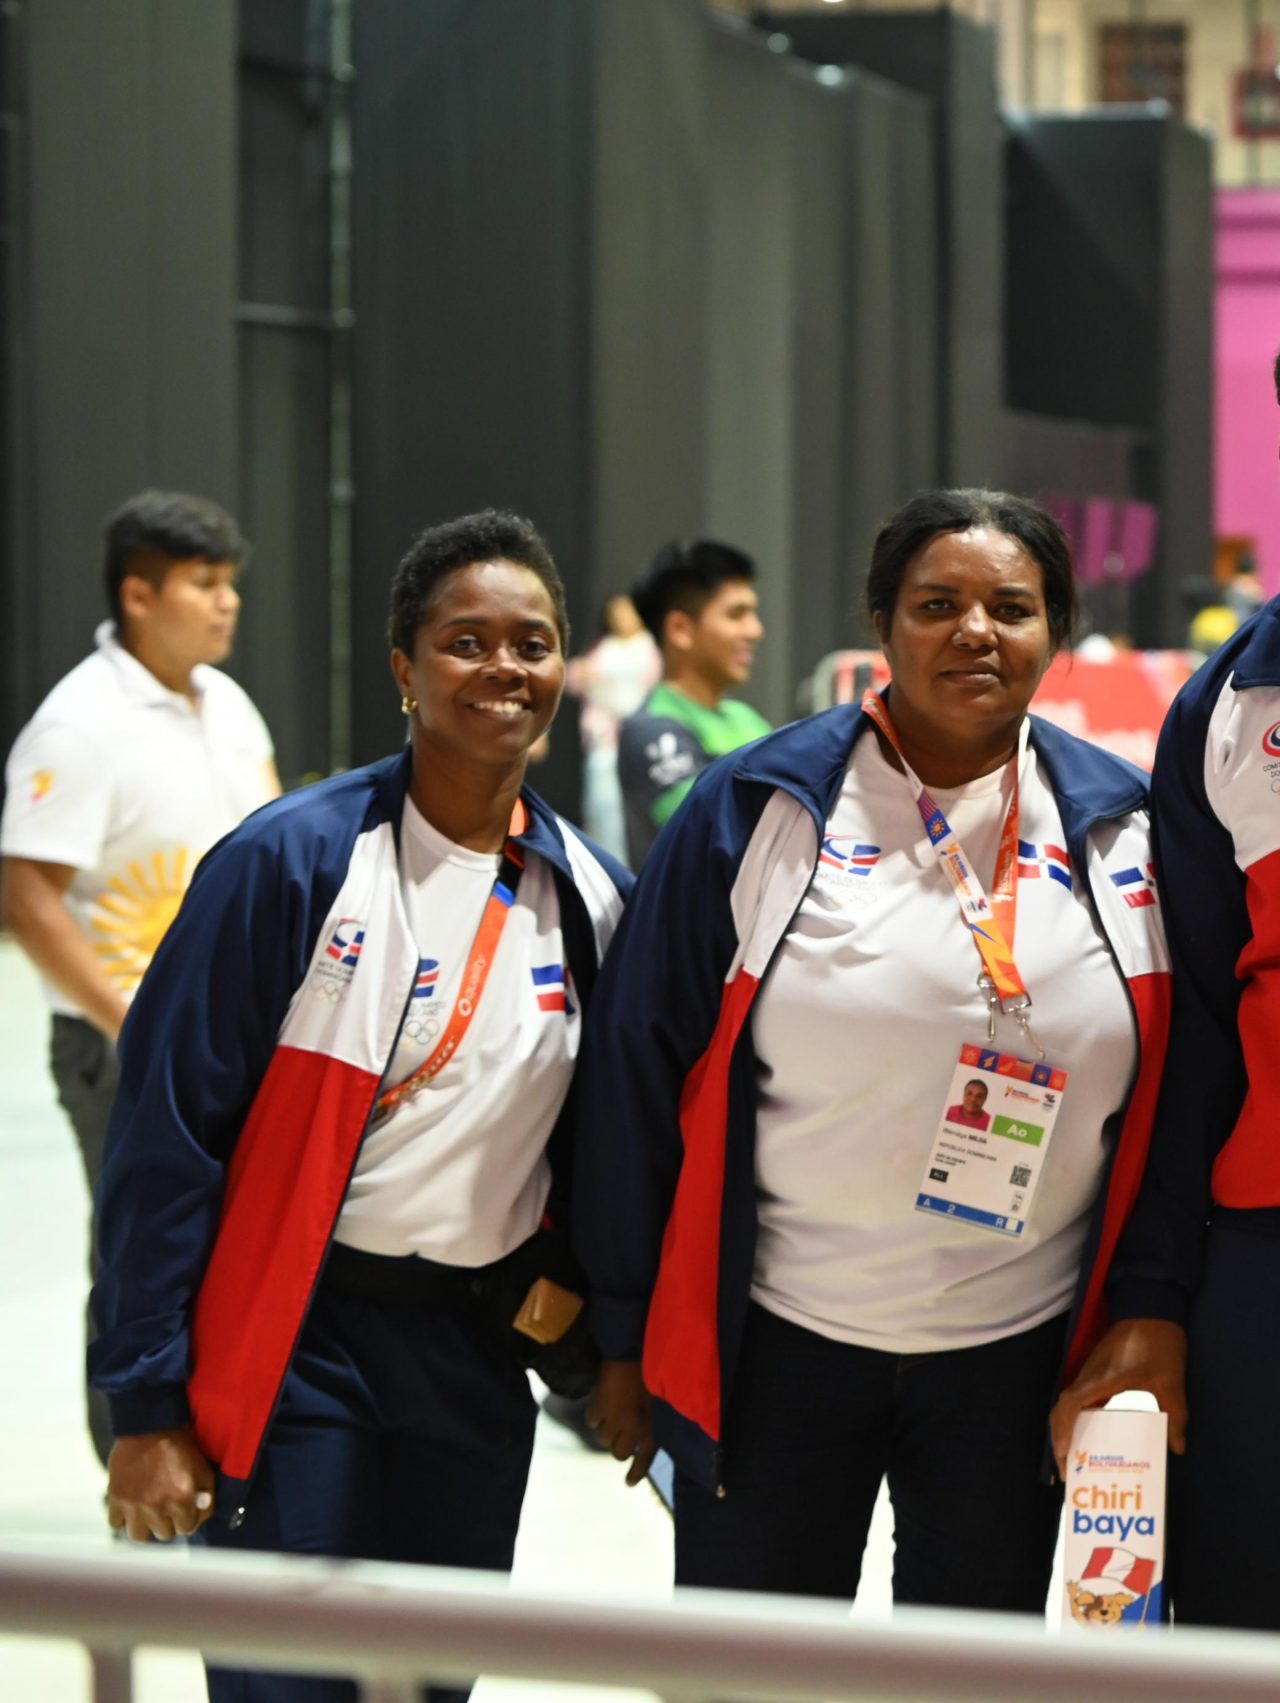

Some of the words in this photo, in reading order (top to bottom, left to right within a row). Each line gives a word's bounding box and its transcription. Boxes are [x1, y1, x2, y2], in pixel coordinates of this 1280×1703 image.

[1007, 1124, 1028, 1137] Ao
[923, 1198, 931, 1207] A
[947, 1204, 956, 1214] 2
[995, 1217, 1005, 1227] R
[1088, 1461, 1151, 1469] BOLIVARIANOS
[1072, 1484, 1142, 1510] Chiri
[1073, 1509, 1155, 1542] baya
